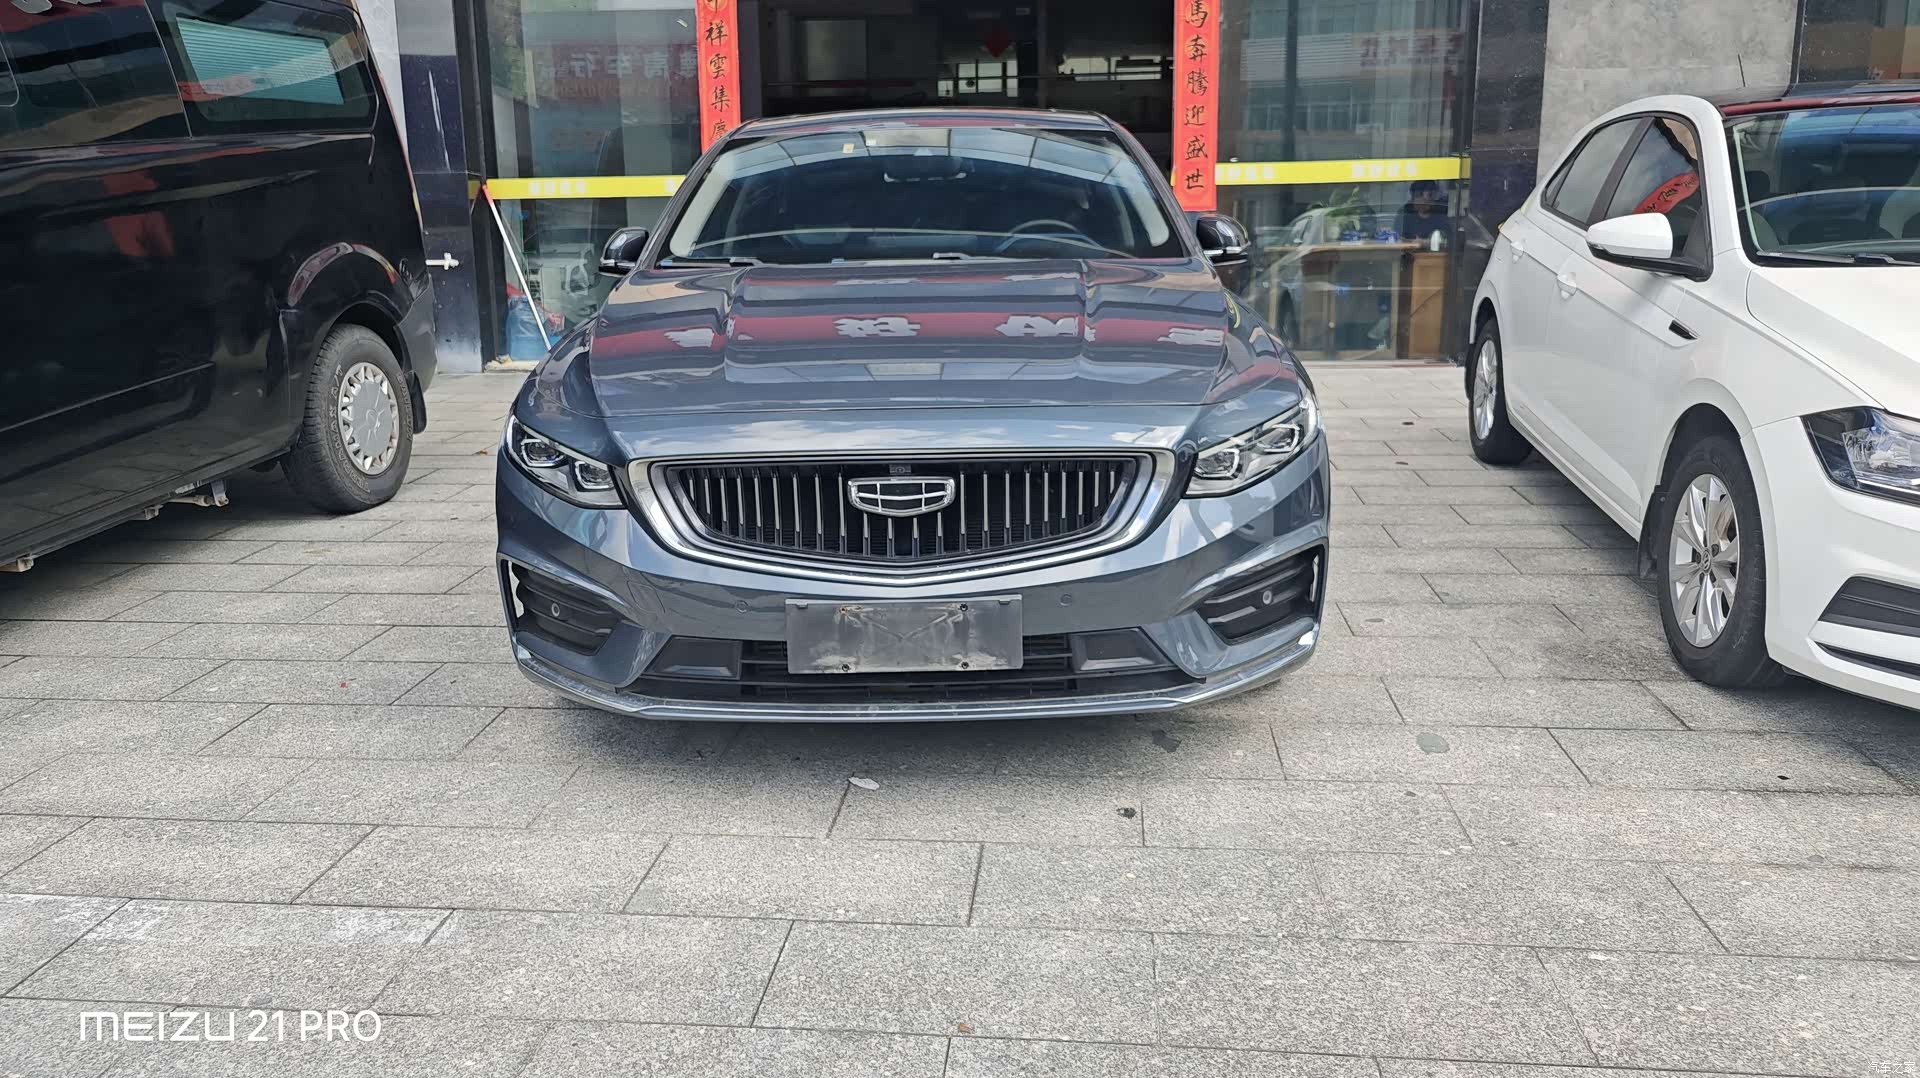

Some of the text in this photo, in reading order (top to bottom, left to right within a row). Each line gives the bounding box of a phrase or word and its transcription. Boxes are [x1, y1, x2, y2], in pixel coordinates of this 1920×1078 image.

[1184, 0, 1209, 189] 馬奔騰迎盛世
